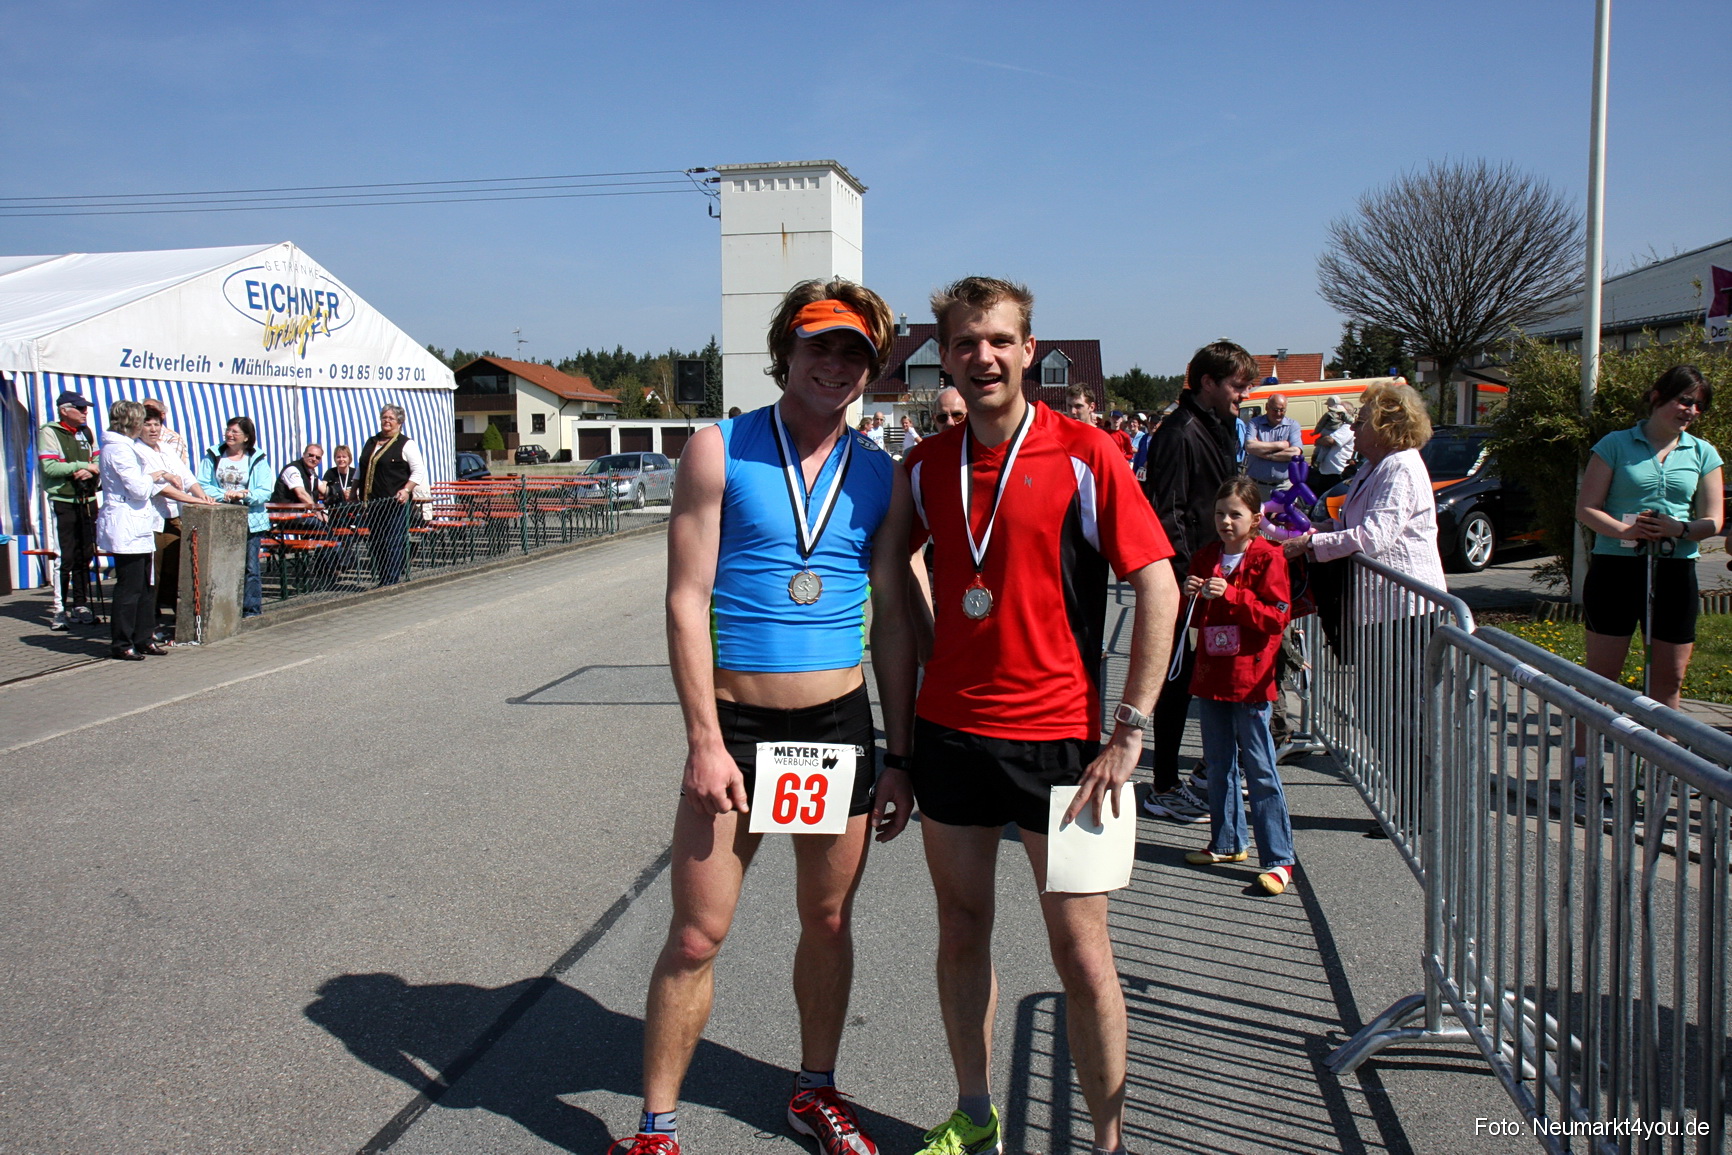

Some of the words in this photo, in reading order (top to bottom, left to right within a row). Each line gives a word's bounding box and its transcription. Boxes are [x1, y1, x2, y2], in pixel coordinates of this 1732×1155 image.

[265, 261, 319, 280] GETRÄNKE
[245, 280, 340, 319] EICHNER
[120, 348, 211, 373] Zeltverleih
[231, 357, 312, 379] Mühlhausen
[774, 746, 819, 758] MEYER
[774, 757, 819, 767] WERBUNG
[772, 772, 828, 825] 63
